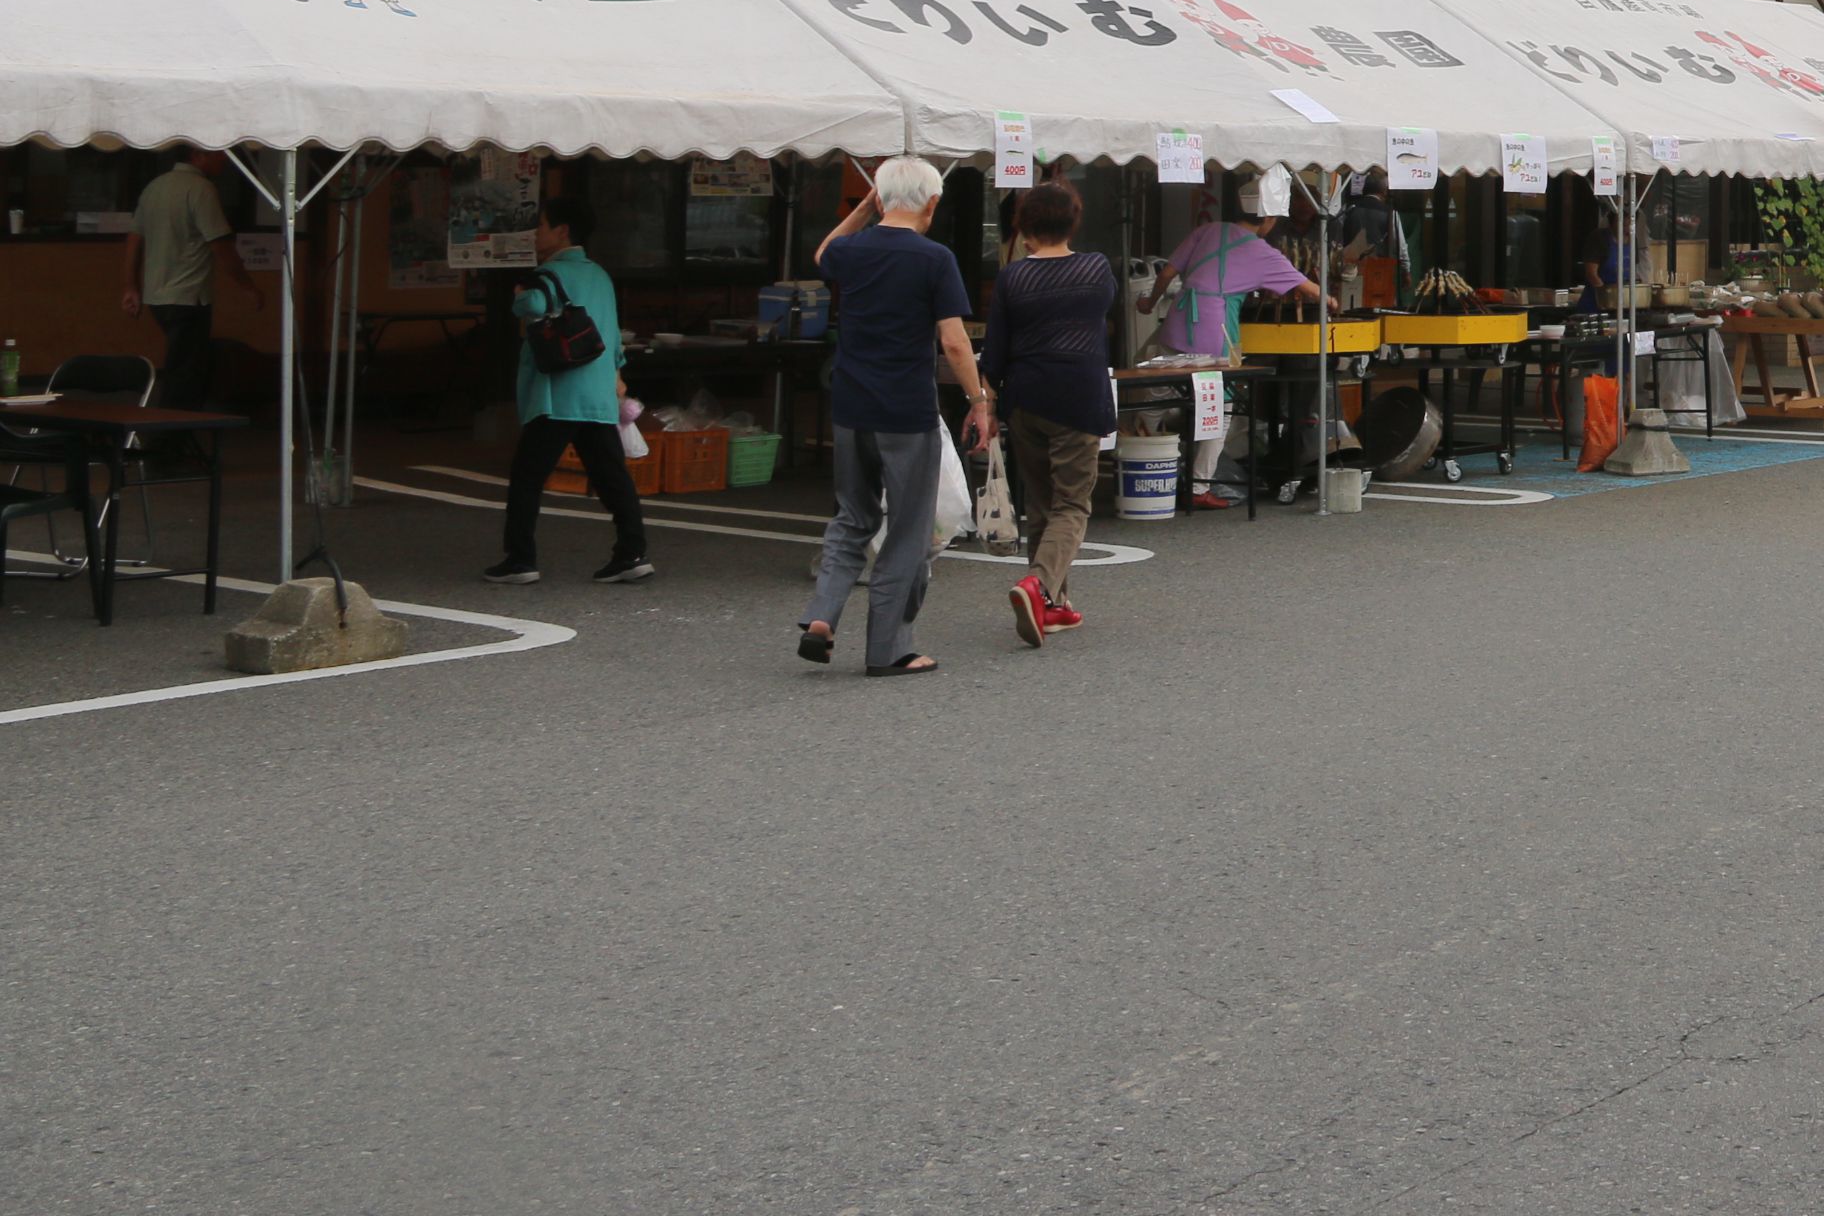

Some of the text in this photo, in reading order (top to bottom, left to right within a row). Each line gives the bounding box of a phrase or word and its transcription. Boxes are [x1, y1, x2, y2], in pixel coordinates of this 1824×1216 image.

[1309, 24, 1464, 69] 農園
[1506, 38, 1737, 87] どりいむ
